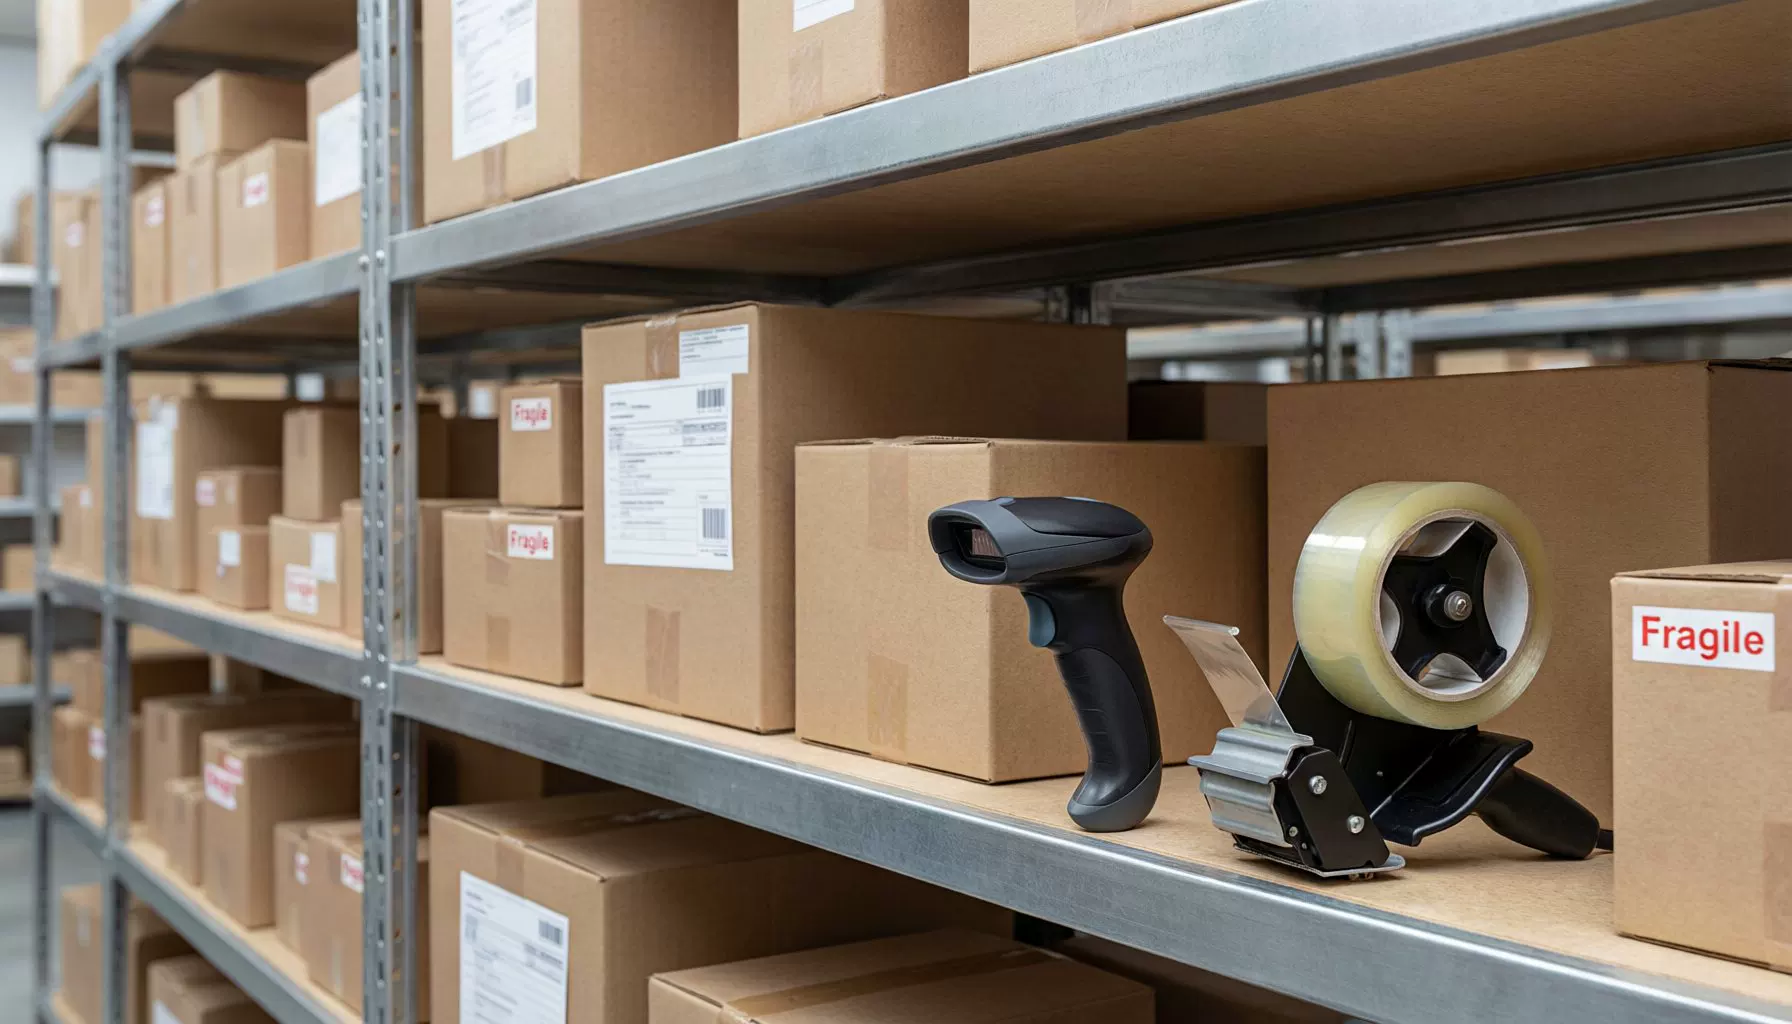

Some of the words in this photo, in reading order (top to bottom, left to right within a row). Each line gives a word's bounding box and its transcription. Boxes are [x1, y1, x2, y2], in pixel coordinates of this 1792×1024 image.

[515, 403, 548, 427] Fragile
[511, 529, 549, 555] Fragile
[1641, 615, 1764, 660] Fragile
